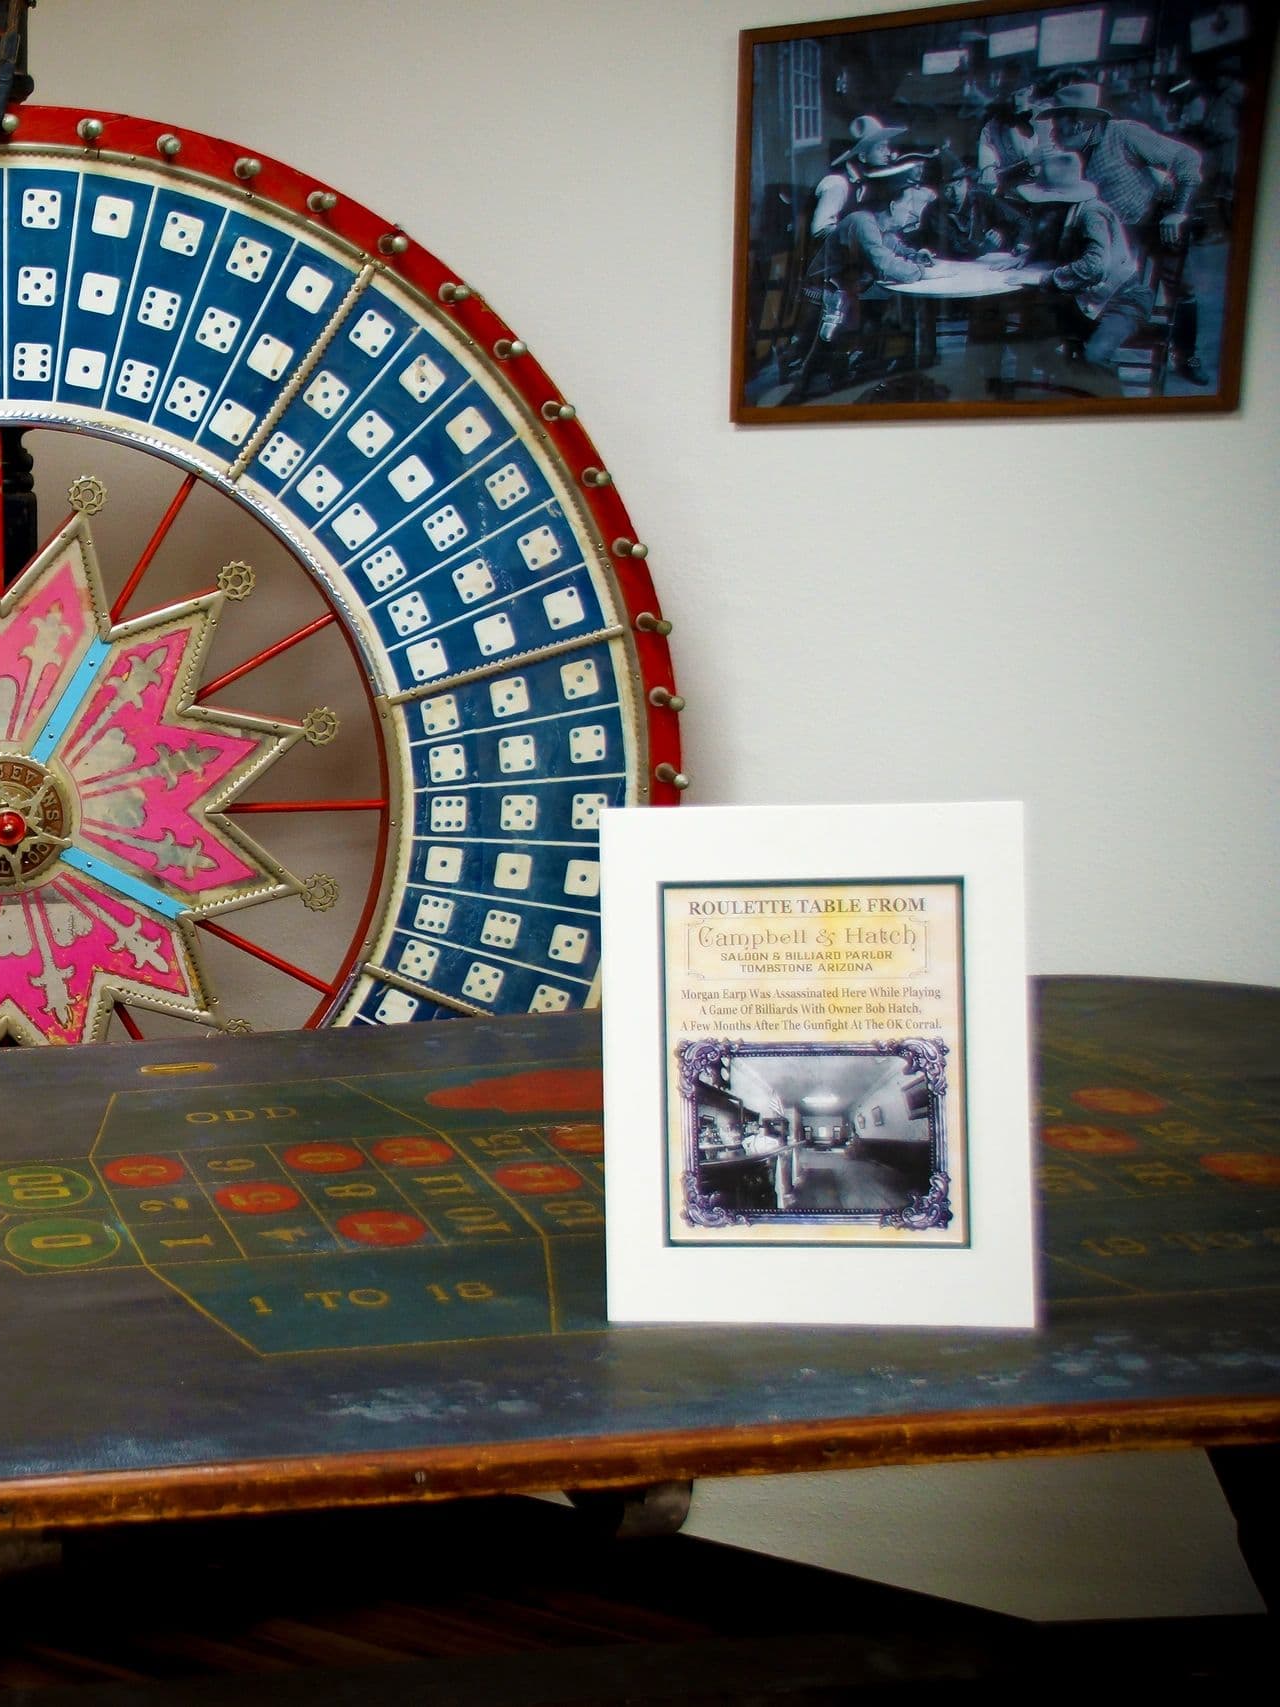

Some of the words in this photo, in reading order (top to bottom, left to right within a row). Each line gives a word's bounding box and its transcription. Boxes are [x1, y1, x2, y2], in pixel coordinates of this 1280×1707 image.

[688, 900, 793, 915] ROULETTE
[796, 898, 861, 914] TABLE
[867, 897, 926, 912] FROM
[698, 926, 806, 950] Campbell
[815, 929, 836, 947] &
[846, 924, 917, 952] Hatch
[720, 952, 769, 962] SALOON
[773, 952, 780, 961] &
[785, 951, 841, 961] BILLIARD
[845, 950, 893, 960] PARLOR
[740, 963, 813, 973] TOMBSTONE
[818, 962, 873, 972] ARIZONA
[681, 989, 720, 1001] Morgan
[722, 988, 746, 1001] Earp
[749, 988, 772, 999] Was
[773, 987, 839, 999] Assassinated
[841, 987, 867, 998] Here
[869, 986, 900, 998] While
[903, 986, 941, 1000] Playing
[700, 1006, 707, 1015] A
[709, 1005, 738, 1015] Game
[740, 1004, 754, 1015] Of
[755, 1003, 798, 1015] Billiards
[801, 1003, 825, 1014] With
[827, 1004, 863, 1014] Owner
[865, 1003, 885, 1014] Bob
[888, 1003, 922, 1015] Hatch,
[681, 1022, 688, 1031] A
[690, 1021, 710, 1031] Few
[713, 1019, 751, 1031] Months
[754, 1019, 779, 1031] After
[782, 1019, 801, 1031] The
[803, 1019, 848, 1032] Gunfight
[850, 1019, 862, 1030] At
[865, 1019, 884, 1030] The
[886, 1018, 903, 1030] OK
[905, 1018, 942, 1030] Corral.
[185, 1106, 298, 1124] ODD
[469, 1134, 535, 1157] 15
[118, 1163, 169, 1179] 3
[207, 1157, 257, 1172] 6
[7, 1173, 72, 1201] 00
[323, 1182, 378, 1199] 8
[411, 1172, 476, 1196] 11
[138, 1196, 191, 1213] 2
[229, 1189, 282, 1207] 5
[443, 1206, 514, 1233] 10
[352, 1220, 412, 1237] 7
[31, 1233, 94, 1249] 0
[159, 1233, 214, 1248] 1
[248, 1295, 272, 1314] 1
[305, 1287, 390, 1310] TO
[426, 1280, 496, 1303] 18
